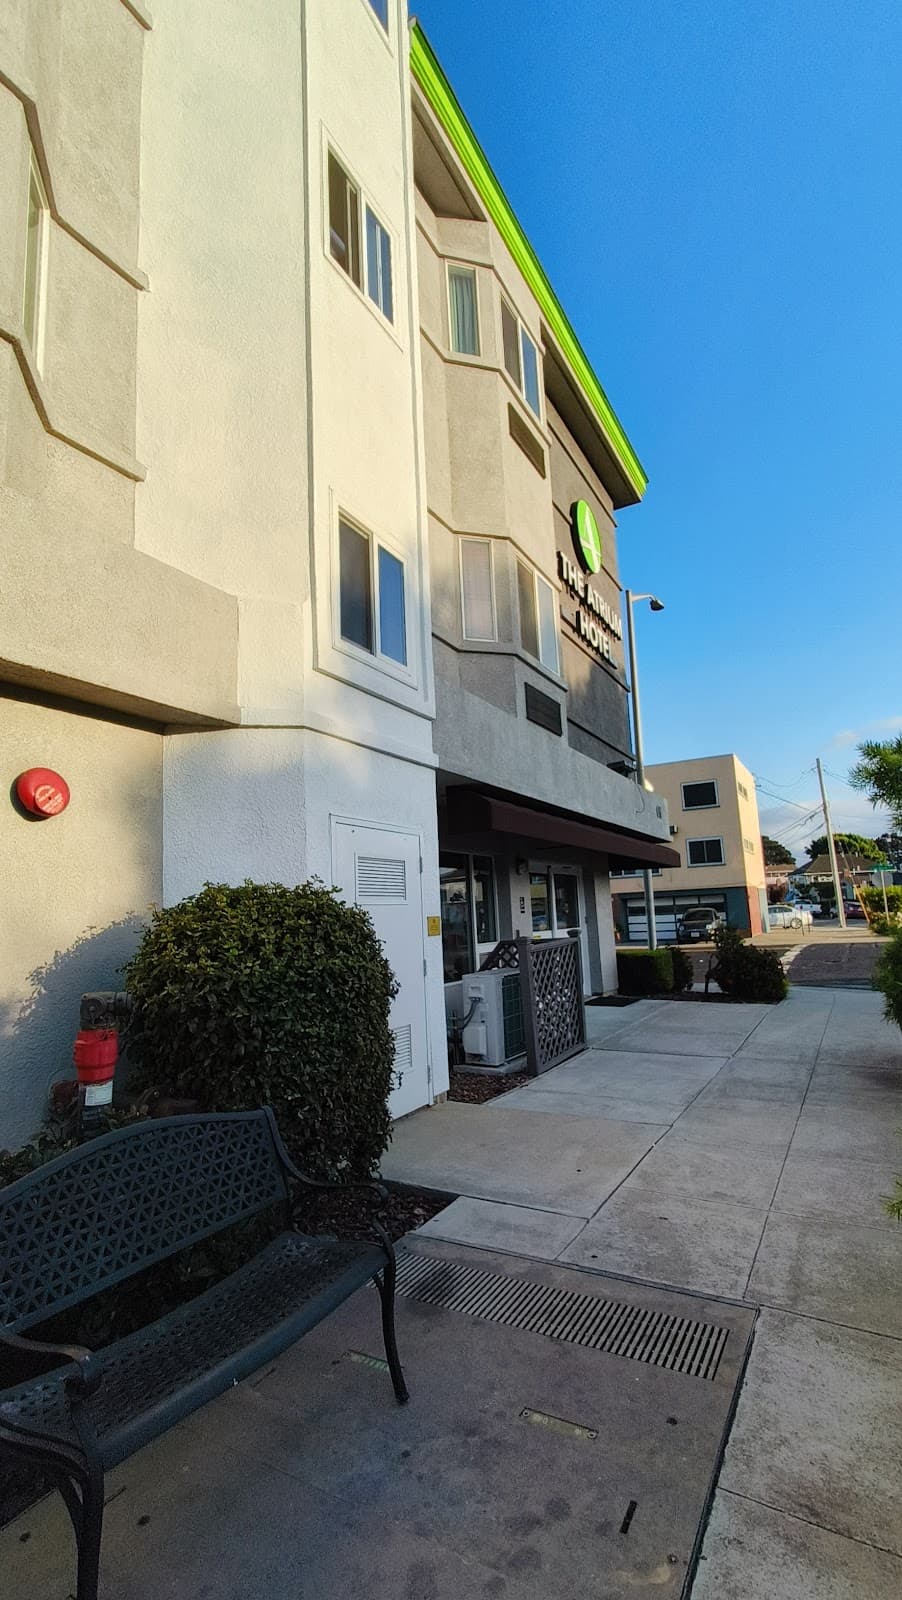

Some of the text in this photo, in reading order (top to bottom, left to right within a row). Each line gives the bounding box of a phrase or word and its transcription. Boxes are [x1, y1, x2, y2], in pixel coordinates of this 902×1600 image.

[558, 550, 623, 640] THE ATRIUM
[578, 610, 618, 669] HOTEL
